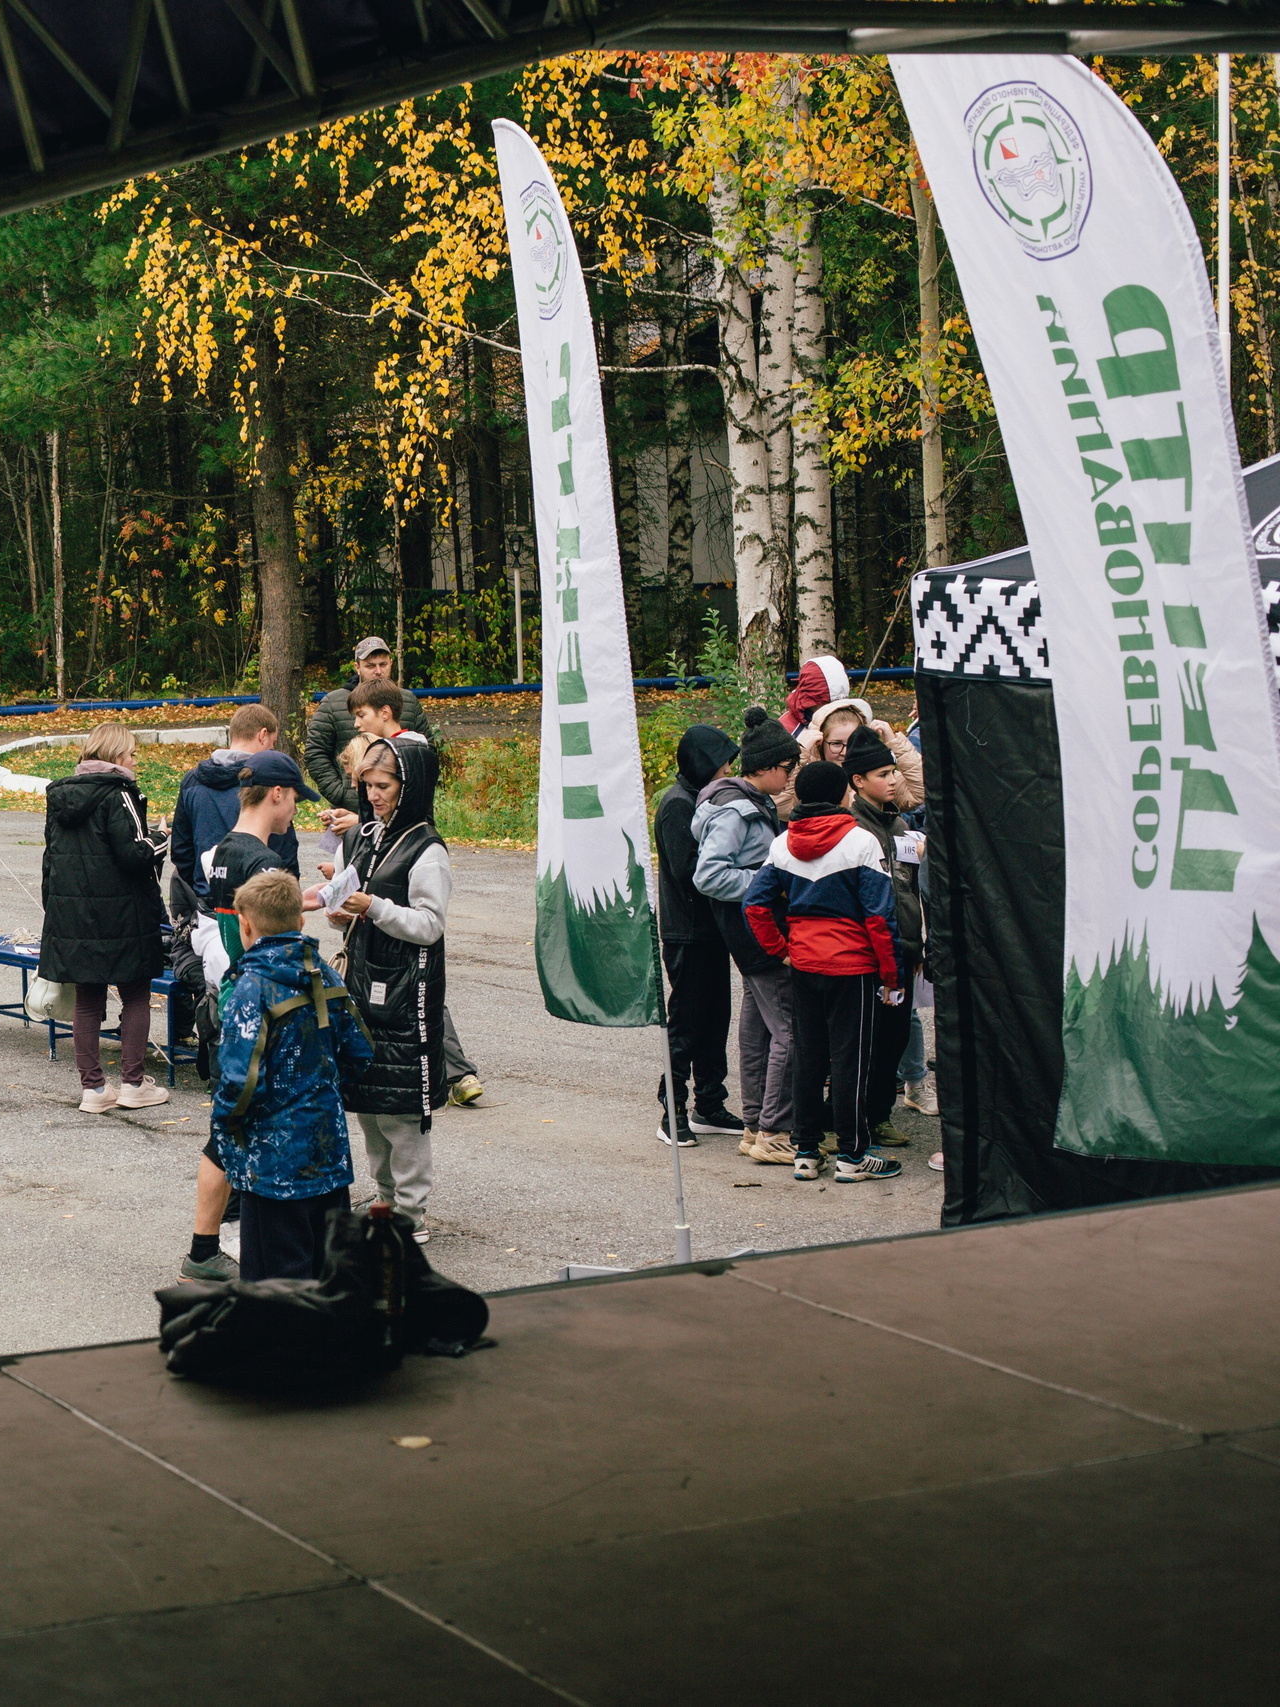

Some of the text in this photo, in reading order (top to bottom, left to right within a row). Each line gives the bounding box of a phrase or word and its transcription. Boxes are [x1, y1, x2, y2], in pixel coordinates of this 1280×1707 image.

[419, 947, 428, 969] BEST
[418, 982, 428, 1043] BEST CLASSIC
[422, 1055, 431, 1117] BEST CLASSIC
